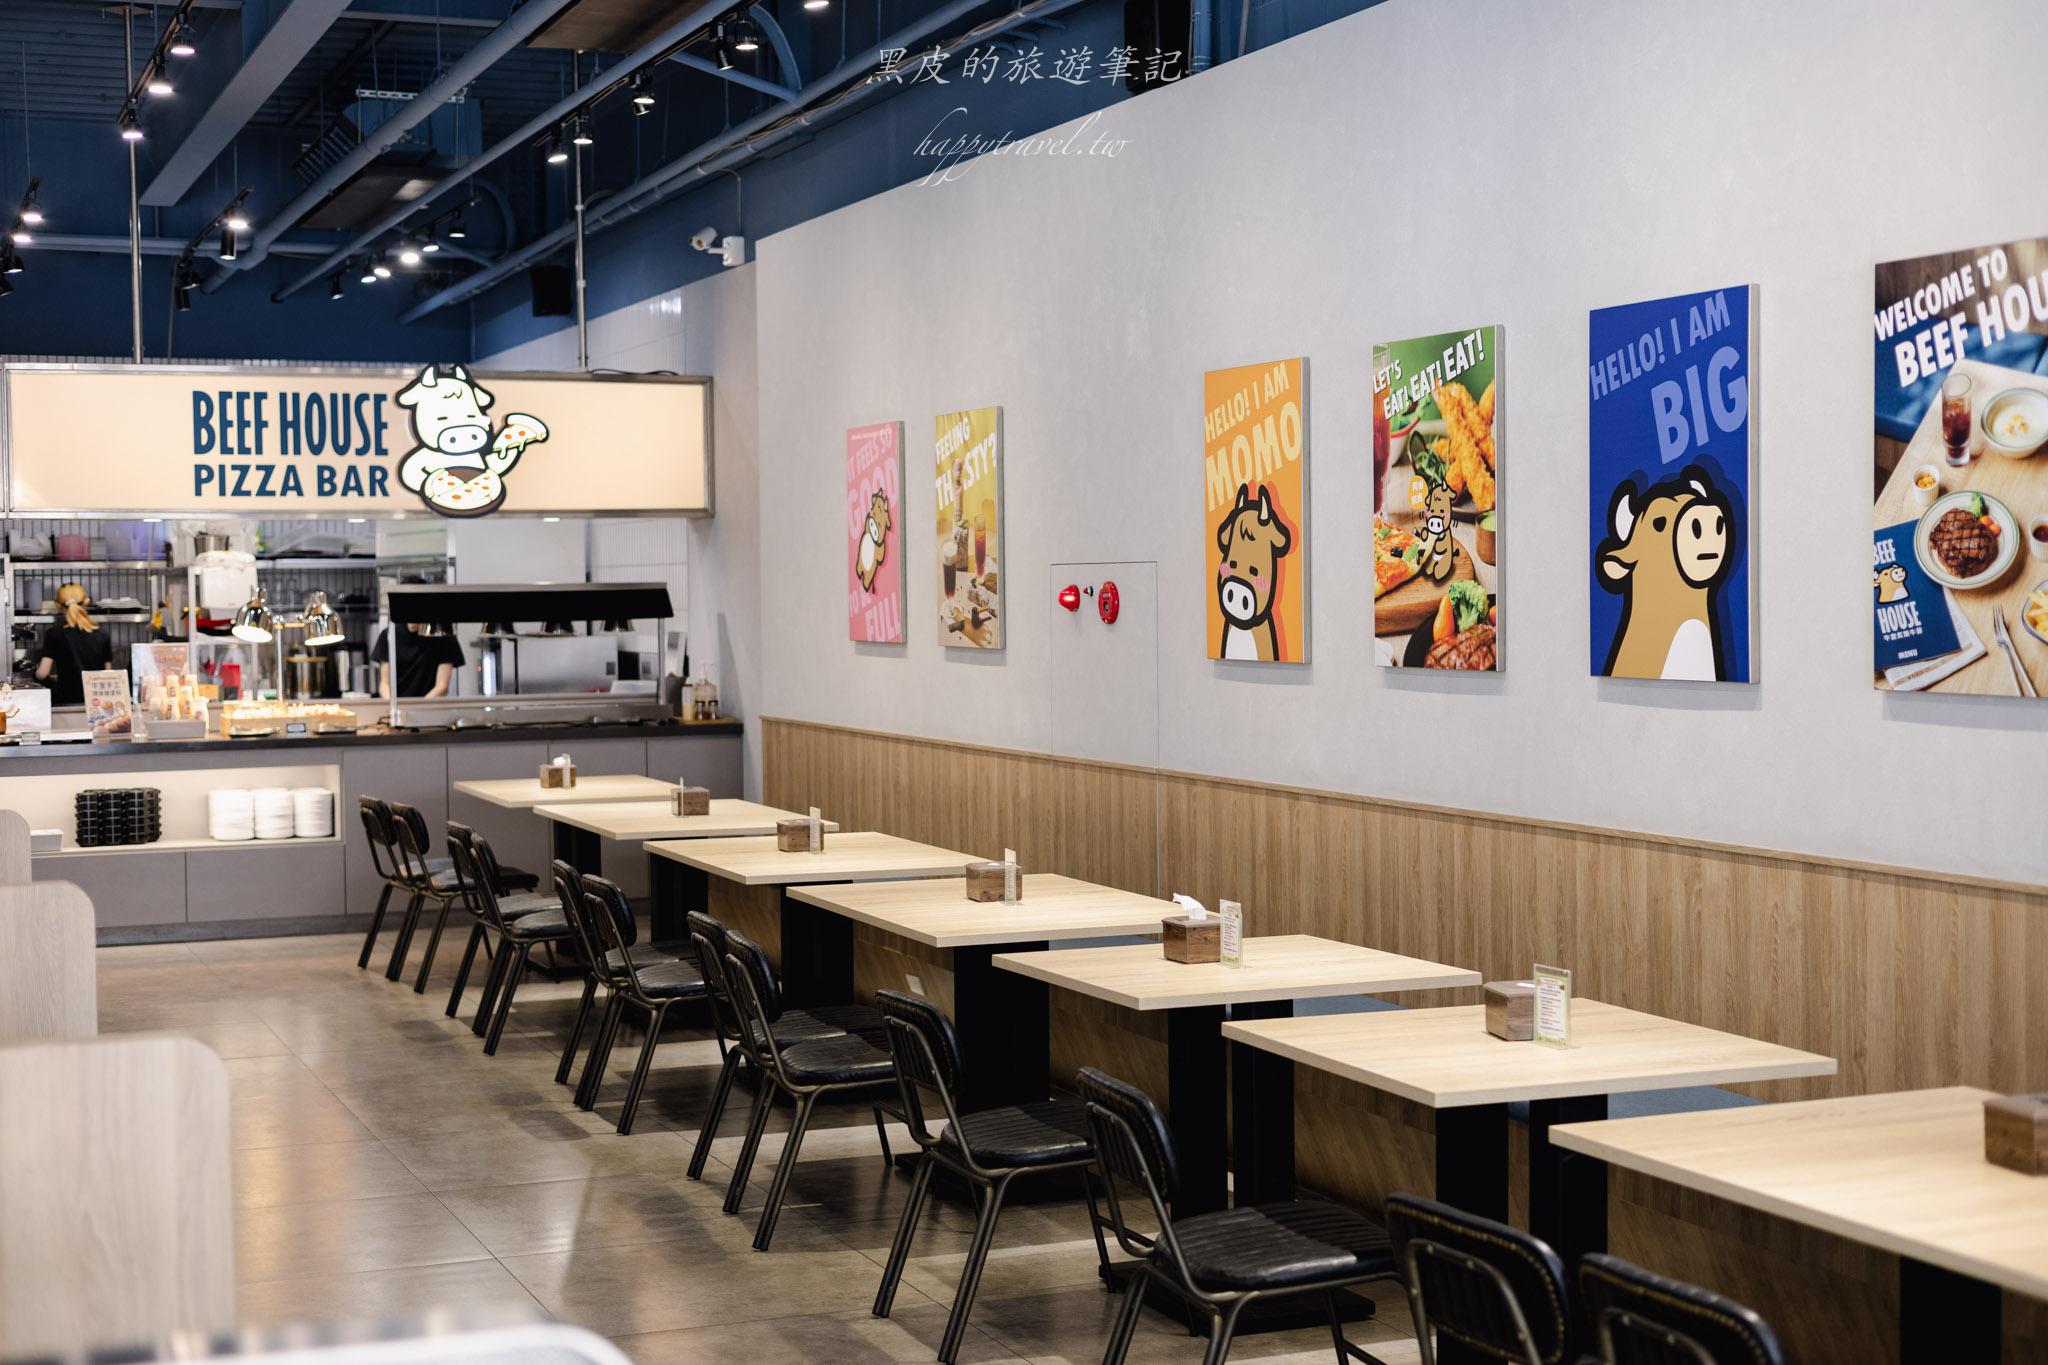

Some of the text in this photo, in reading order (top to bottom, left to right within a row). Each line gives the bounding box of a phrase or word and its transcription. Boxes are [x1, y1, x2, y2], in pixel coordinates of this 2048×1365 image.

[1875, 248, 2008, 342] WELCOME TO
[1373, 359, 1402, 394] LET'S
[1383, 329, 1485, 420] EAT! EAT! EAT!
[1590, 290, 1731, 401] HELLO! I AM
[1895, 311, 1968, 388] BEEF
[192, 390, 390, 456] BEEF HOUSE
[935, 416, 970, 465] FEELING
[1205, 361, 1290, 443] HELLO! I AM
[1651, 346, 1748, 465] BIG
[194, 464, 390, 497] PIZZA BAR
[936, 432, 997, 511] THSTY?
[1206, 401, 1302, 512] MOMO
[848, 457, 899, 540] GOOD
[865, 591, 901, 642] FULL
[1877, 601, 1922, 634] HOUSE
[1898, 649, 1918, 660] MENU
